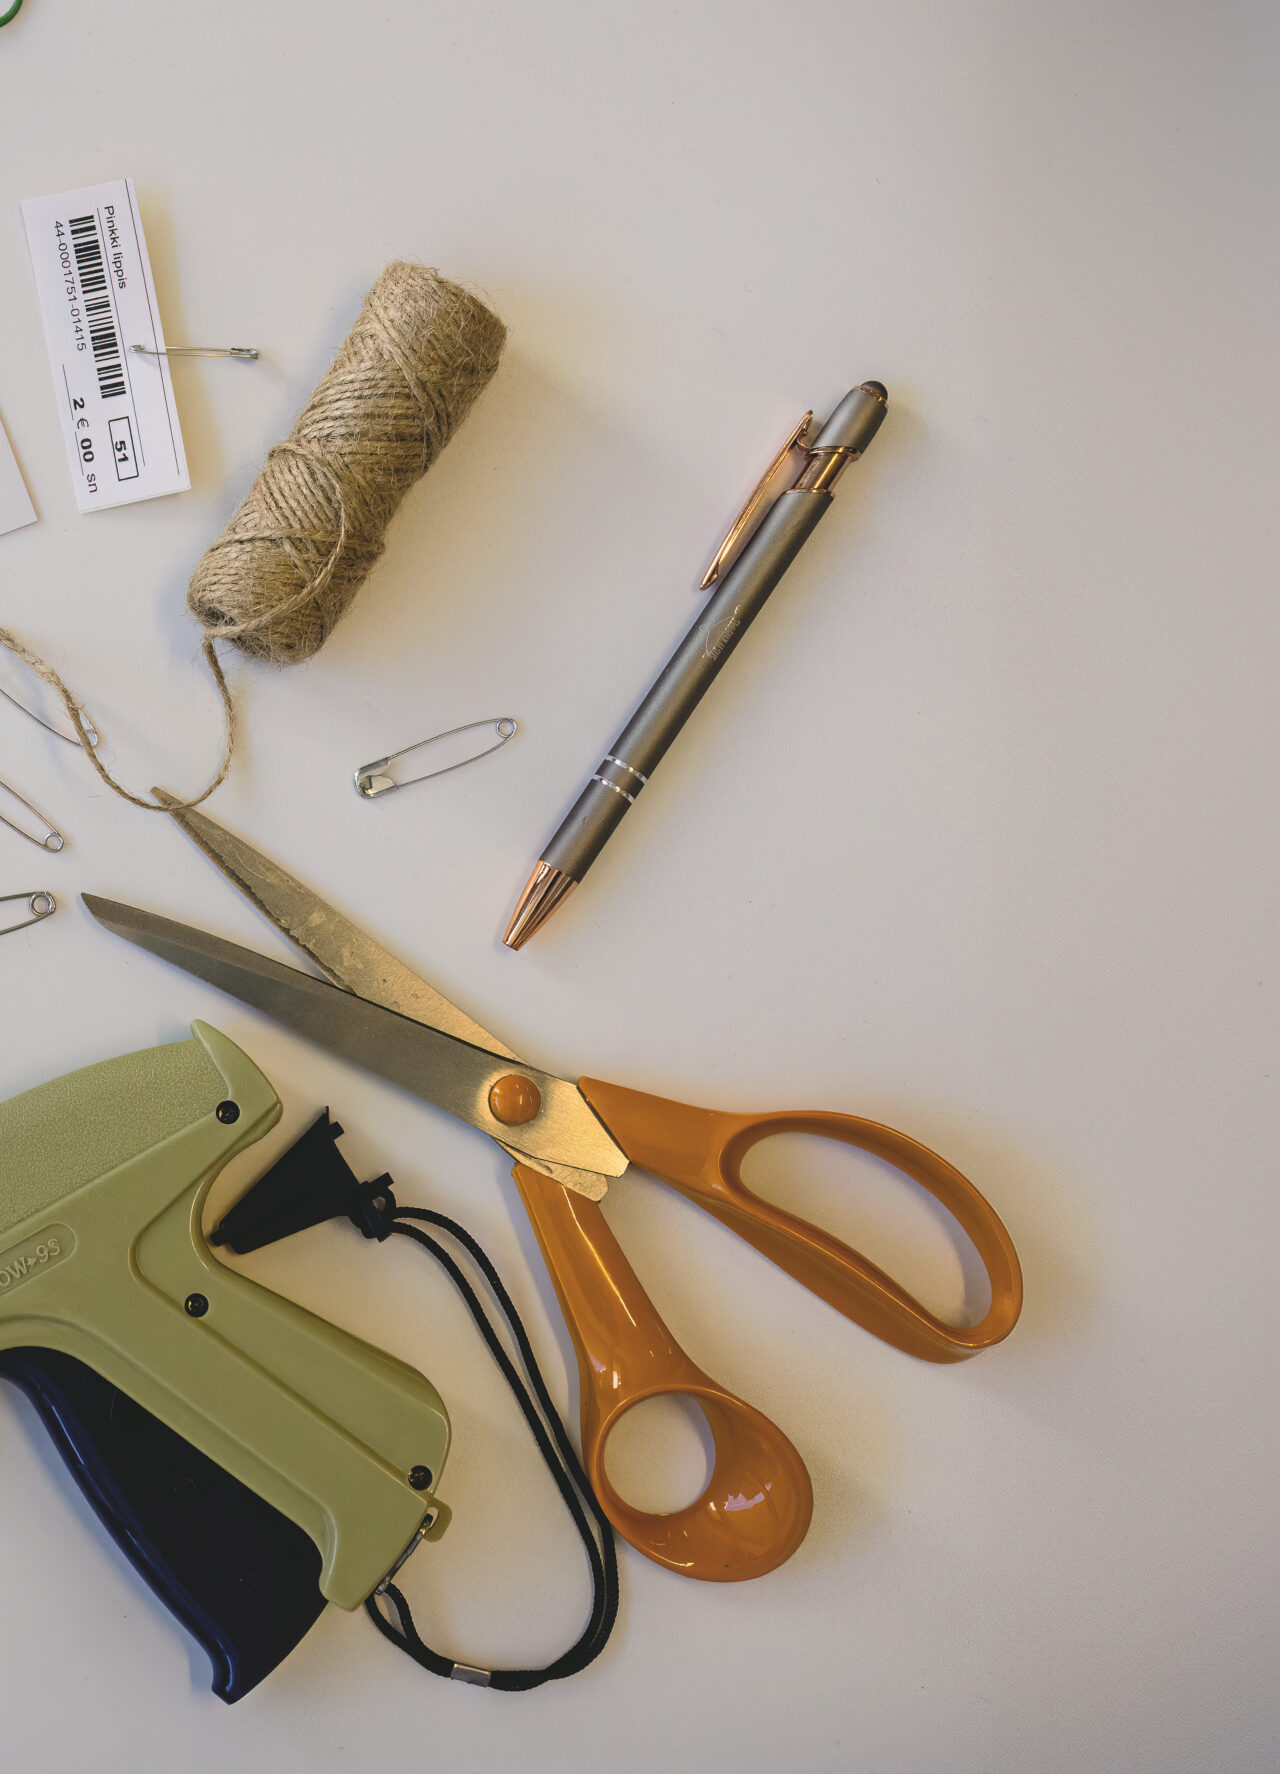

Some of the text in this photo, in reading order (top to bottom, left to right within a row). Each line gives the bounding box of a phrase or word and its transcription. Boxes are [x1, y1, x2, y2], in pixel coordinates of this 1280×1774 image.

[104, 205, 126, 289] Pinkki lippis
[54, 220, 87, 351] 44-0001751-01415
[72, 397, 85, 410] 2
[76, 417, 89, 429] €
[80, 438, 95, 463] 00
[114, 440, 129, 464] 51
